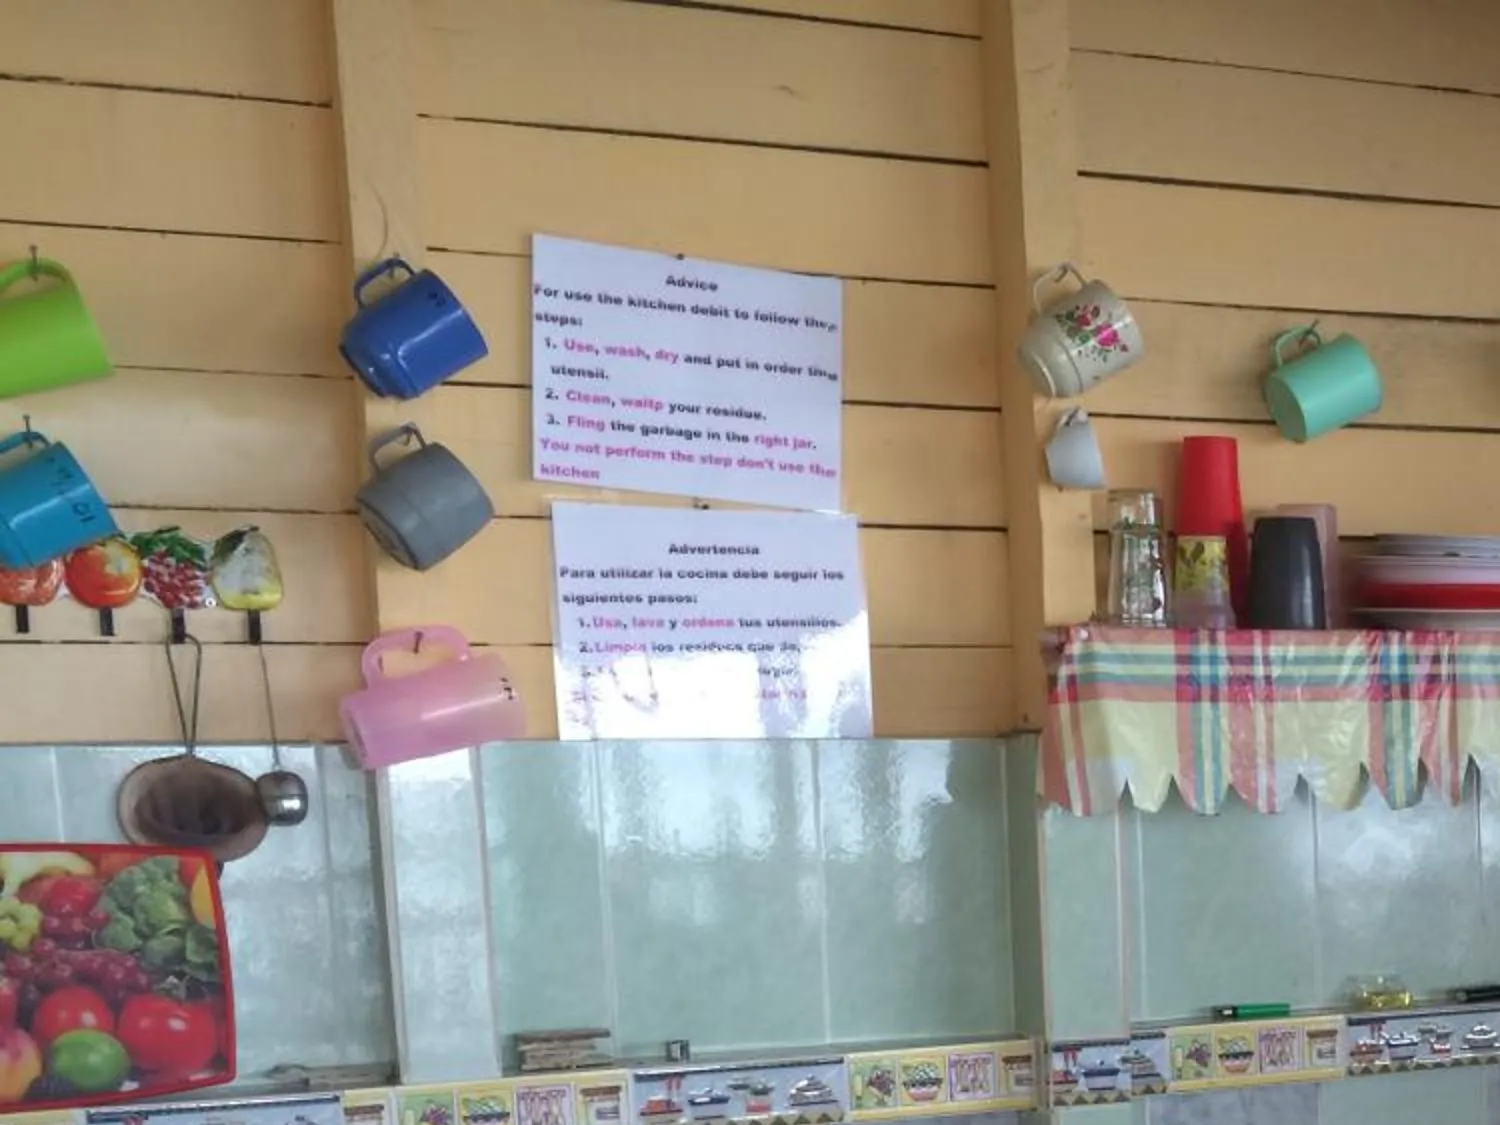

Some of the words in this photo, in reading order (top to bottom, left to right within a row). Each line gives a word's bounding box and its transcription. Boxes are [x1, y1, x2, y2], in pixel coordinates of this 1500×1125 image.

[666, 275, 718, 291] Advice
[533, 284, 560, 298] For
[564, 289, 593, 302] use
[597, 292, 623, 305] the
[628, 295, 686, 313] kitchen
[690, 304, 729, 318] debit
[734, 308, 749, 320] to
[754, 310, 799, 326] follow
[535, 312, 583, 326] steps:
[564, 339, 600, 356] Use,
[605, 345, 650, 361] wash,
[655, 348, 679, 364] dry
[684, 354, 712, 365] and
[716, 357, 740, 369] put
[746, 359, 759, 370] in
[764, 362, 802, 375] order
[545, 387, 558, 400] 2.
[566, 389, 616, 408] Clean,
[669, 401, 701, 414] your
[706, 405, 767, 420] residue.
[547, 413, 560, 425] 3.
[567, 415, 606, 432] Fling
[610, 419, 635, 432] the
[640, 422, 702, 441] garbage
[707, 429, 720, 441] in
[725, 430, 749, 443] the
[754, 434, 789, 448] right
[793, 436, 817, 450] jar.
[540, 437, 569, 451] You
[575, 442, 601, 455] not
[605, 444, 665, 460] perform
[671, 450, 694, 463] the
[700, 453, 732, 468] step
[737, 456, 775, 471] don't
[779, 461, 805, 473] use
[540, 463, 600, 480] kitchen
[669, 543, 760, 555] Advertencia
[560, 566, 595, 578] Para
[600, 567, 653, 579] utilizar
[659, 567, 672, 579] la
[676, 568, 728, 579] cocina
[732, 568, 768, 579] debe
[773, 569, 818, 582] seguir
[823, 569, 844, 580] los
[562, 592, 643, 606] siguientes
[648, 593, 698, 605] pasos:
[632, 615, 665, 628] lava
[668, 619, 678, 631] y
[681, 616, 734, 628] ordena
[739, 617, 762, 628] tus
[651, 641, 674, 653] los
